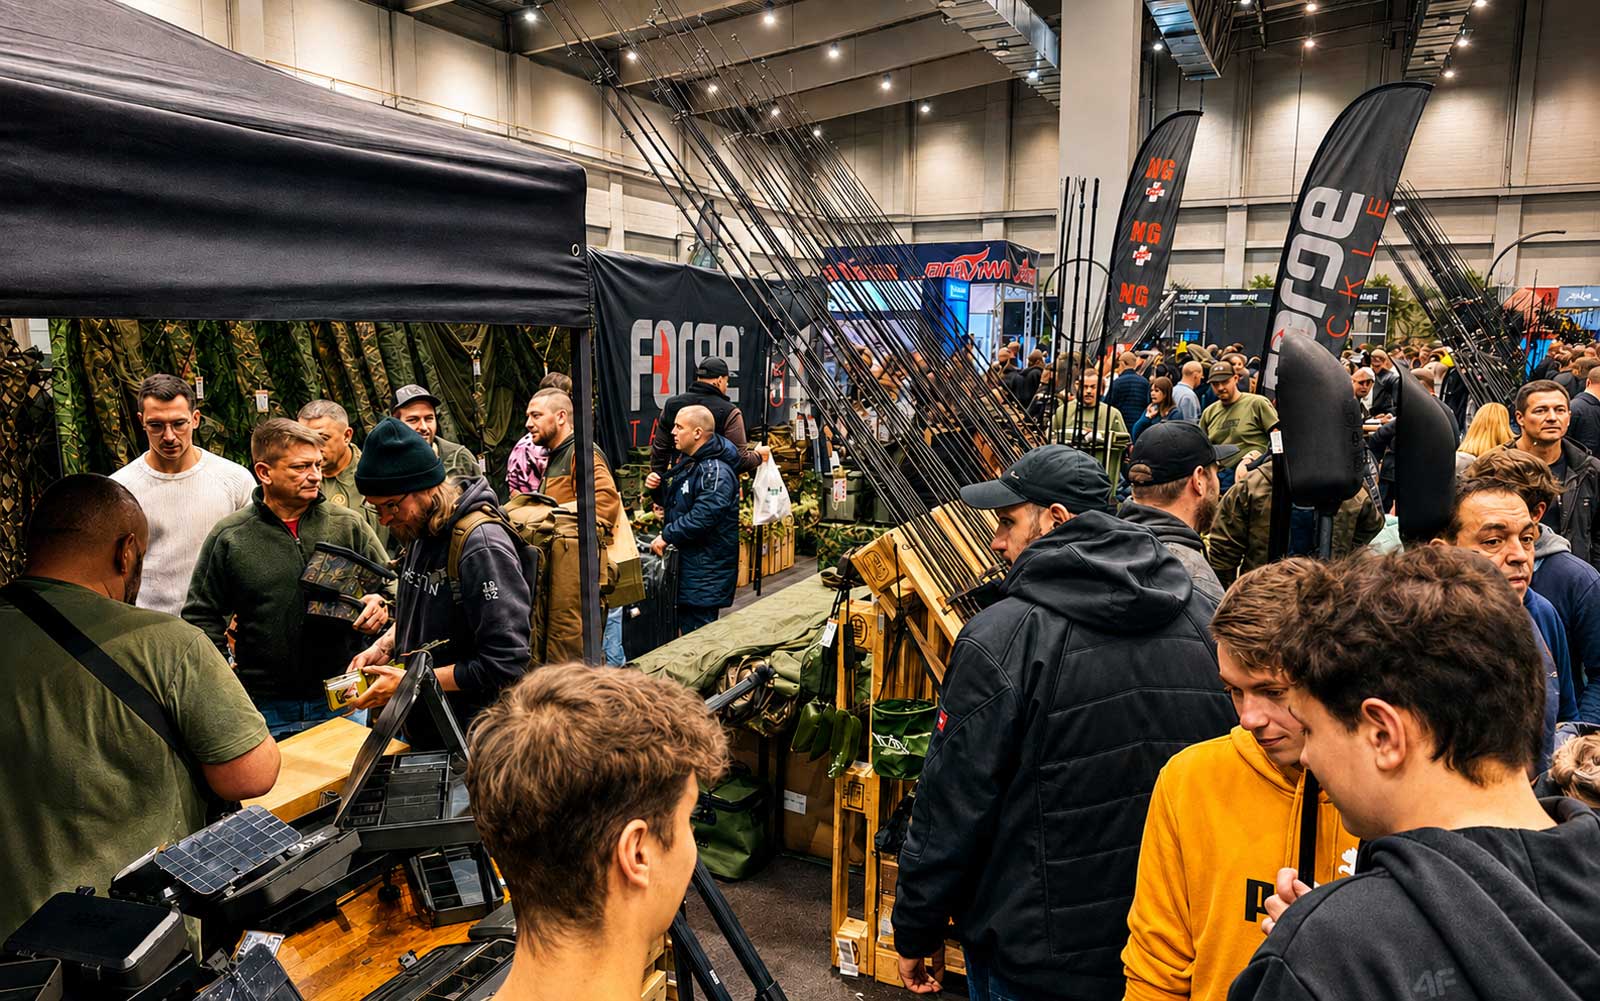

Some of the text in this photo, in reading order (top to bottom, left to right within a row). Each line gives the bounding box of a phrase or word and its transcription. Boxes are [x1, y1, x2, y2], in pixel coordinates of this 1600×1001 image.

[1145, 157, 1176, 181] NG
[1130, 220, 1162, 244] NG
[1119, 282, 1149, 307] NG
